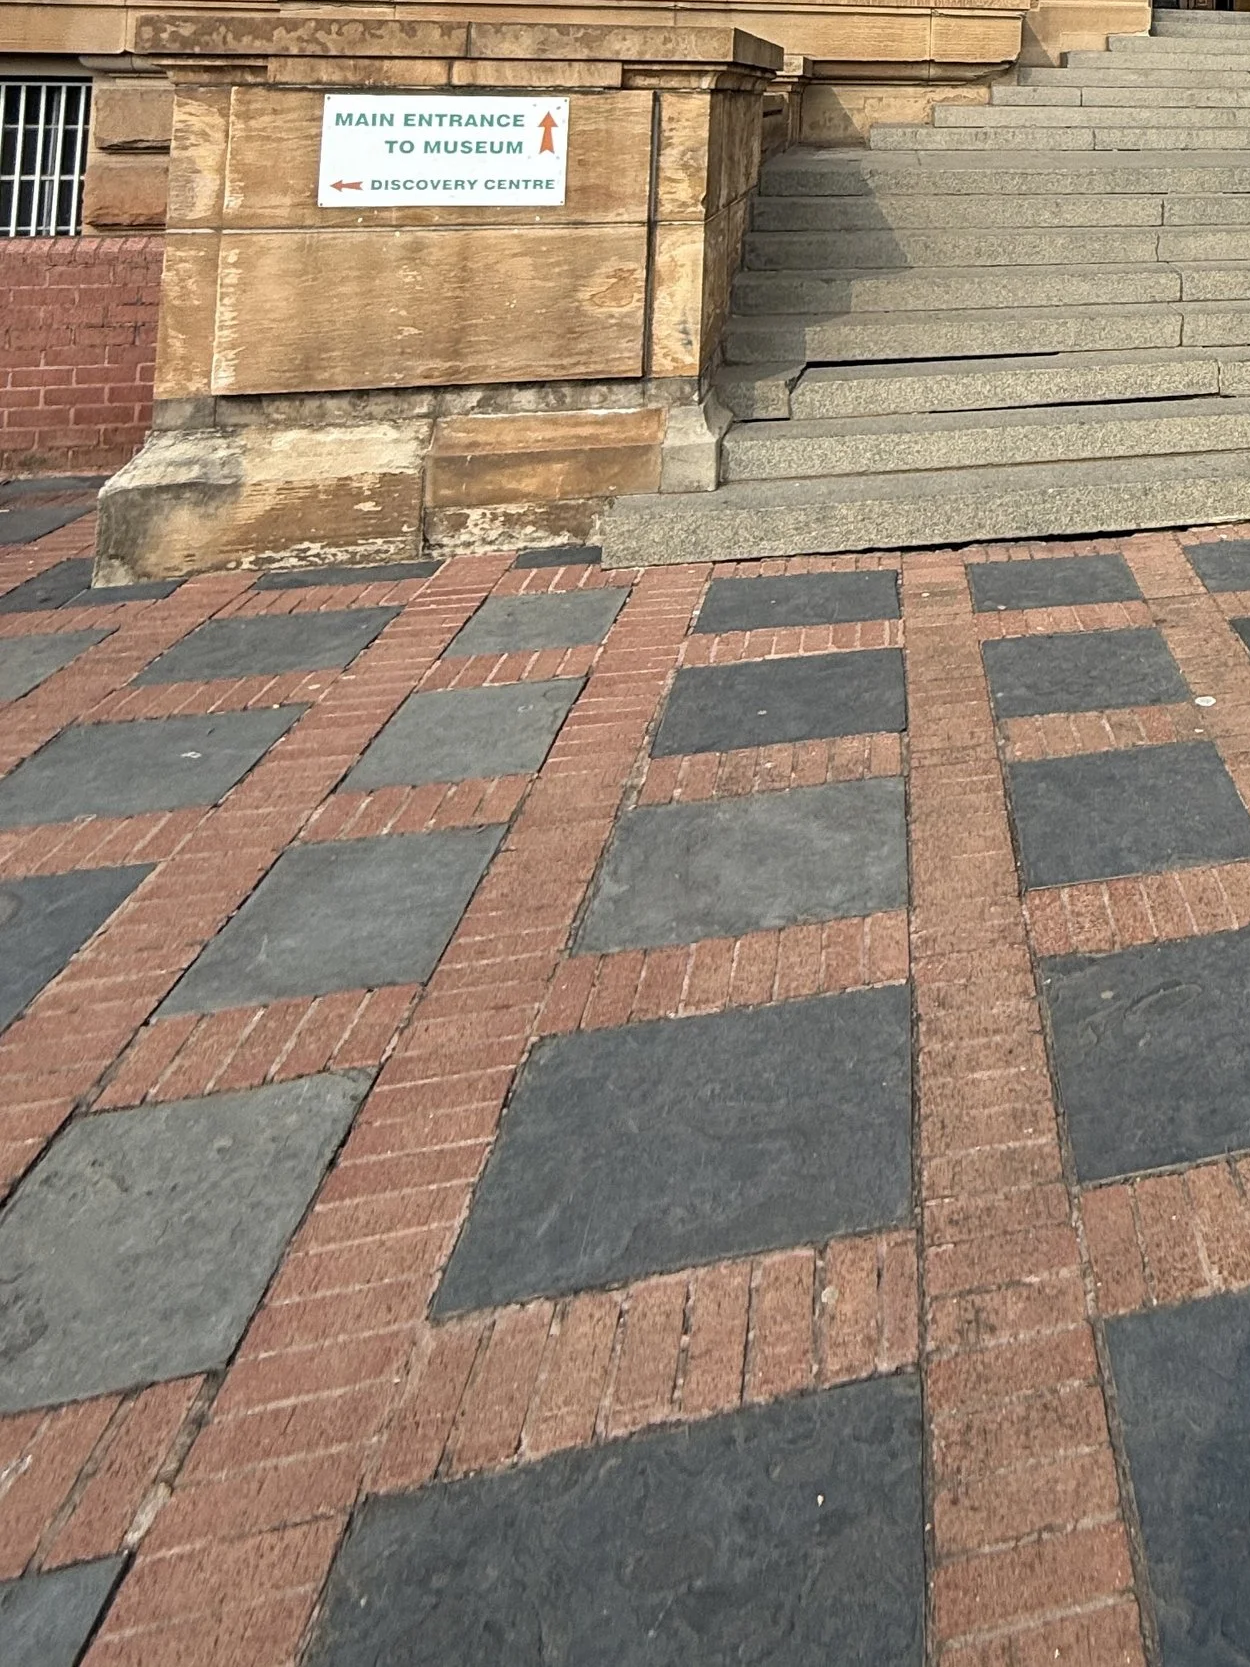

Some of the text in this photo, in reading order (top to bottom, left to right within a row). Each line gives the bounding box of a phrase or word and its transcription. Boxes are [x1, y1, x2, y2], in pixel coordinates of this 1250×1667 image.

[335, 113, 525, 127] MAIN ENTRANCE
[384, 140, 523, 154] TO MUSEUM
[370, 179, 555, 190] DISCOVERY CENTRE
